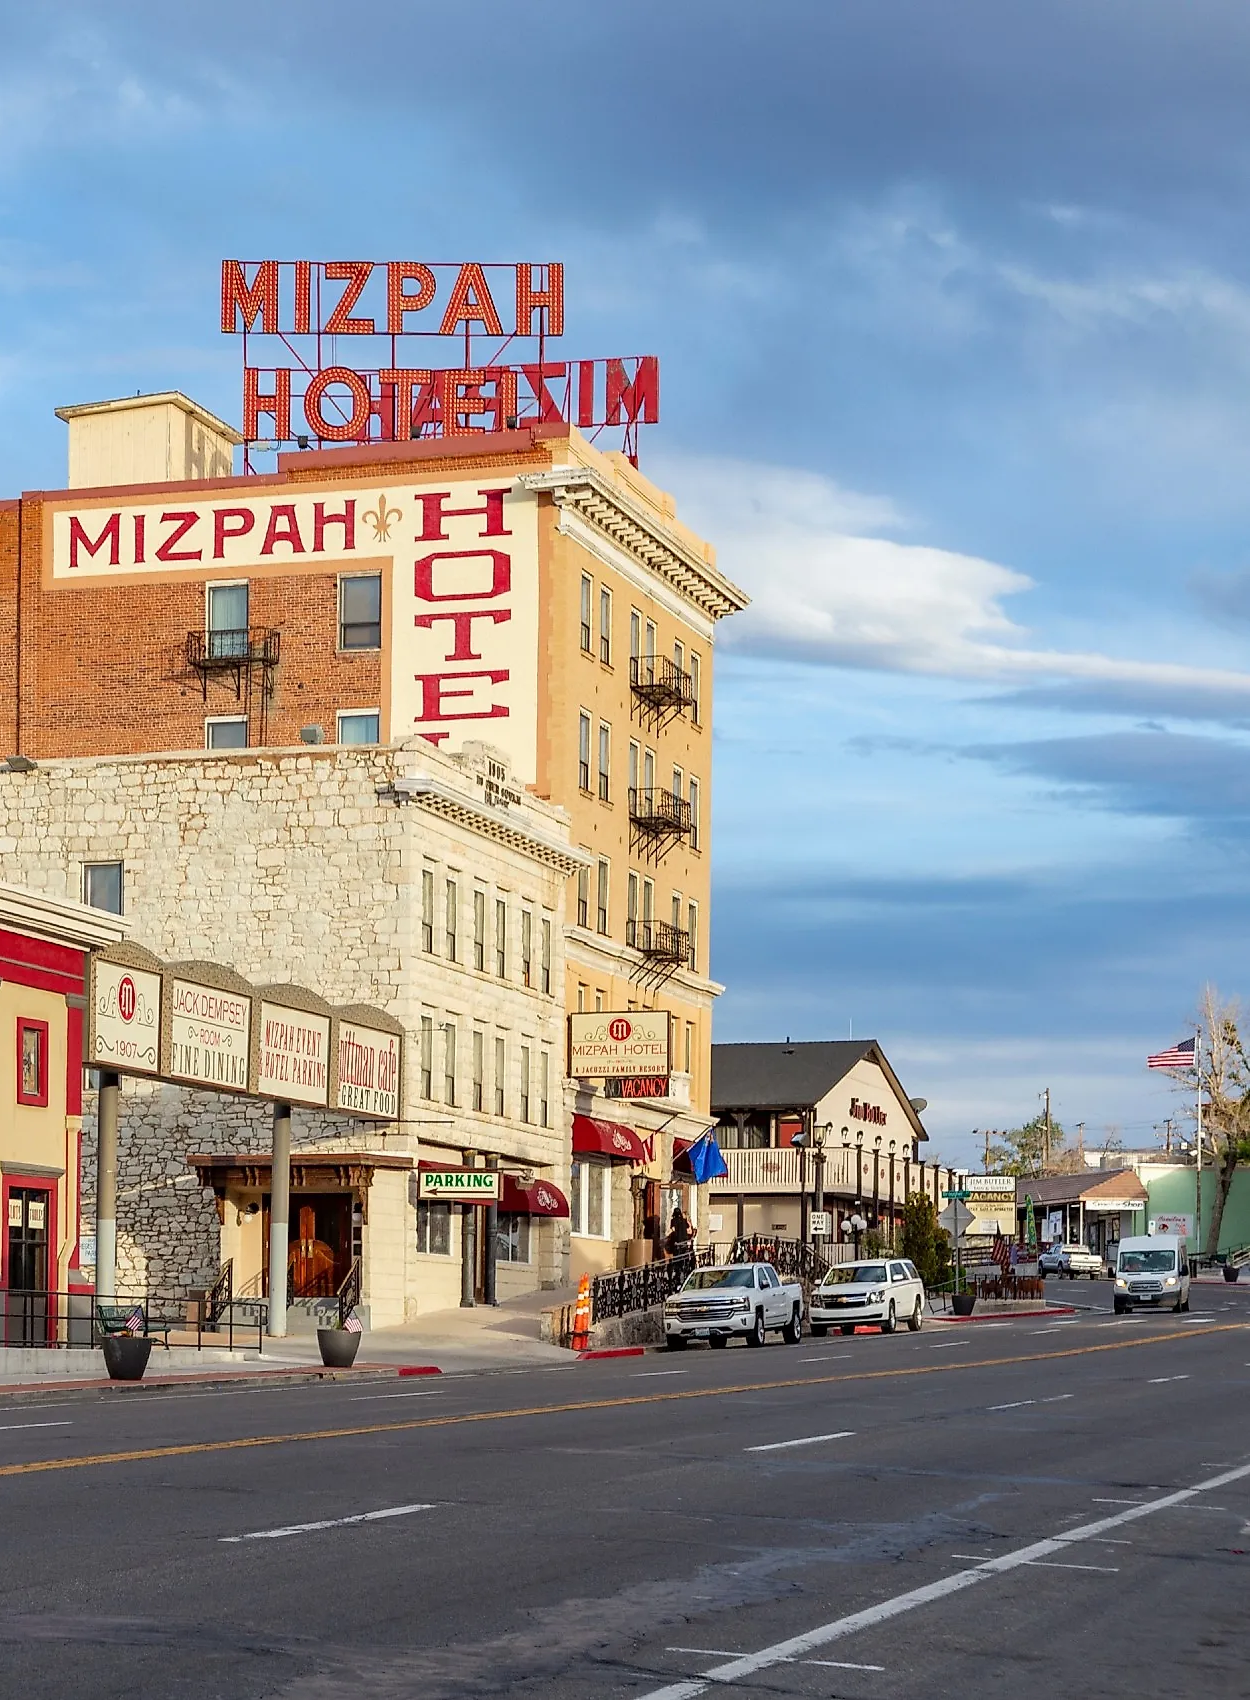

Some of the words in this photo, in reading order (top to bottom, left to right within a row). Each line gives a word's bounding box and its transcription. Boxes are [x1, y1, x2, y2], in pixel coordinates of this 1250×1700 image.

[221, 259, 564, 336] MIZPAH
[68, 499, 357, 568] MIZPAH
[414, 487, 512, 748] HOTE
[173, 988, 200, 1016] JACK
[201, 995, 248, 1026] DEMPSEY
[116, 1040, 137, 1058] 1907
[200, 1028, 221, 1047] ROOM
[265, 1019, 295, 1052] MIZPAH
[295, 1027, 322, 1058] EVENT
[572, 1044, 618, 1056] MIZPAH
[624, 1043, 667, 1055] HOTEL
[172, 1042, 200, 1077] FINE
[204, 1049, 245, 1085] DINING
[265, 1051, 289, 1082] HOTEL
[292, 1057, 326, 1089] PARKING
[338, 1030, 375, 1092] pittman
[582, 1066, 610, 1074] JACUZZI
[612, 1065, 636, 1074] FAMILY
[639, 1065, 665, 1073] RESORT
[341, 1085, 371, 1111] GREAT
[373, 1090, 396, 1115] FOOD
[621, 1078, 668, 1097] VACANCY
[425, 1174, 493, 1188] PARKING
